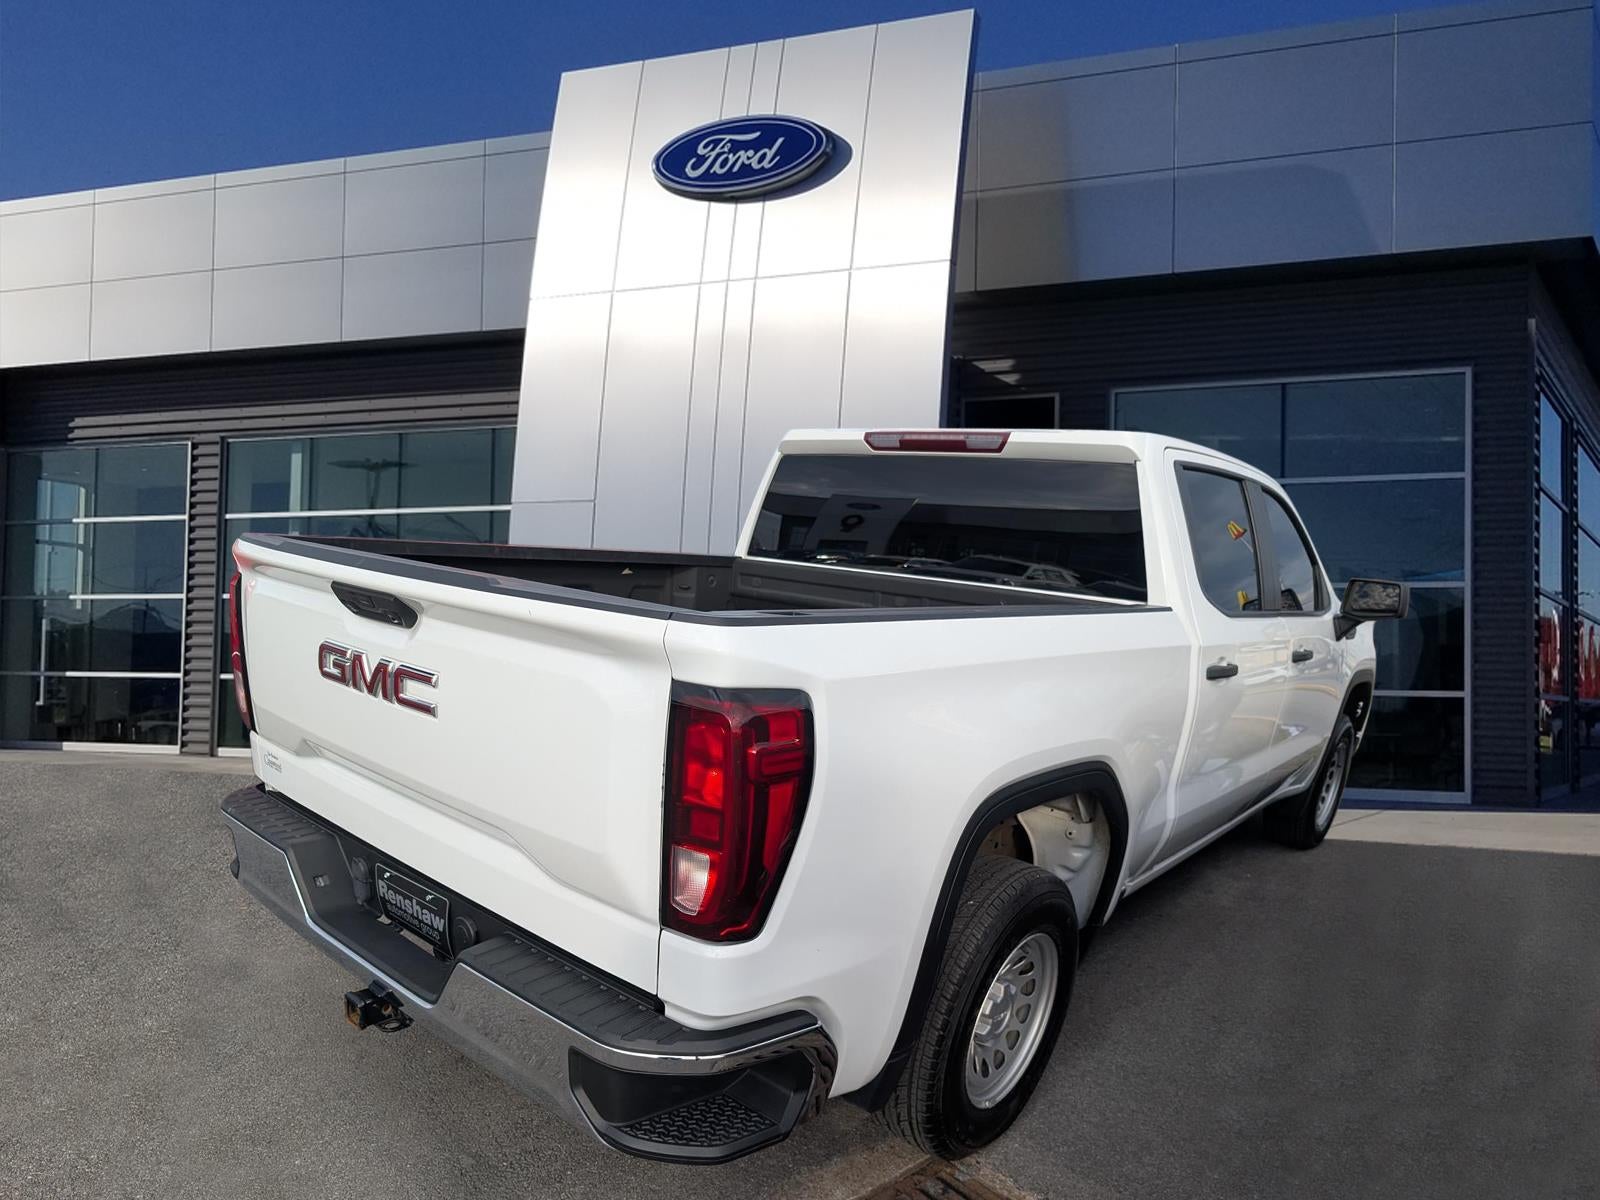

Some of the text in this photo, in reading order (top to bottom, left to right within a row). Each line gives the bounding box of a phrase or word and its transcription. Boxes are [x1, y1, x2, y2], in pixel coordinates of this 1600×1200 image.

[685, 131, 785, 178] Ford
[318, 638, 440, 719] GMC
[378, 879, 444, 932] Renshaw
